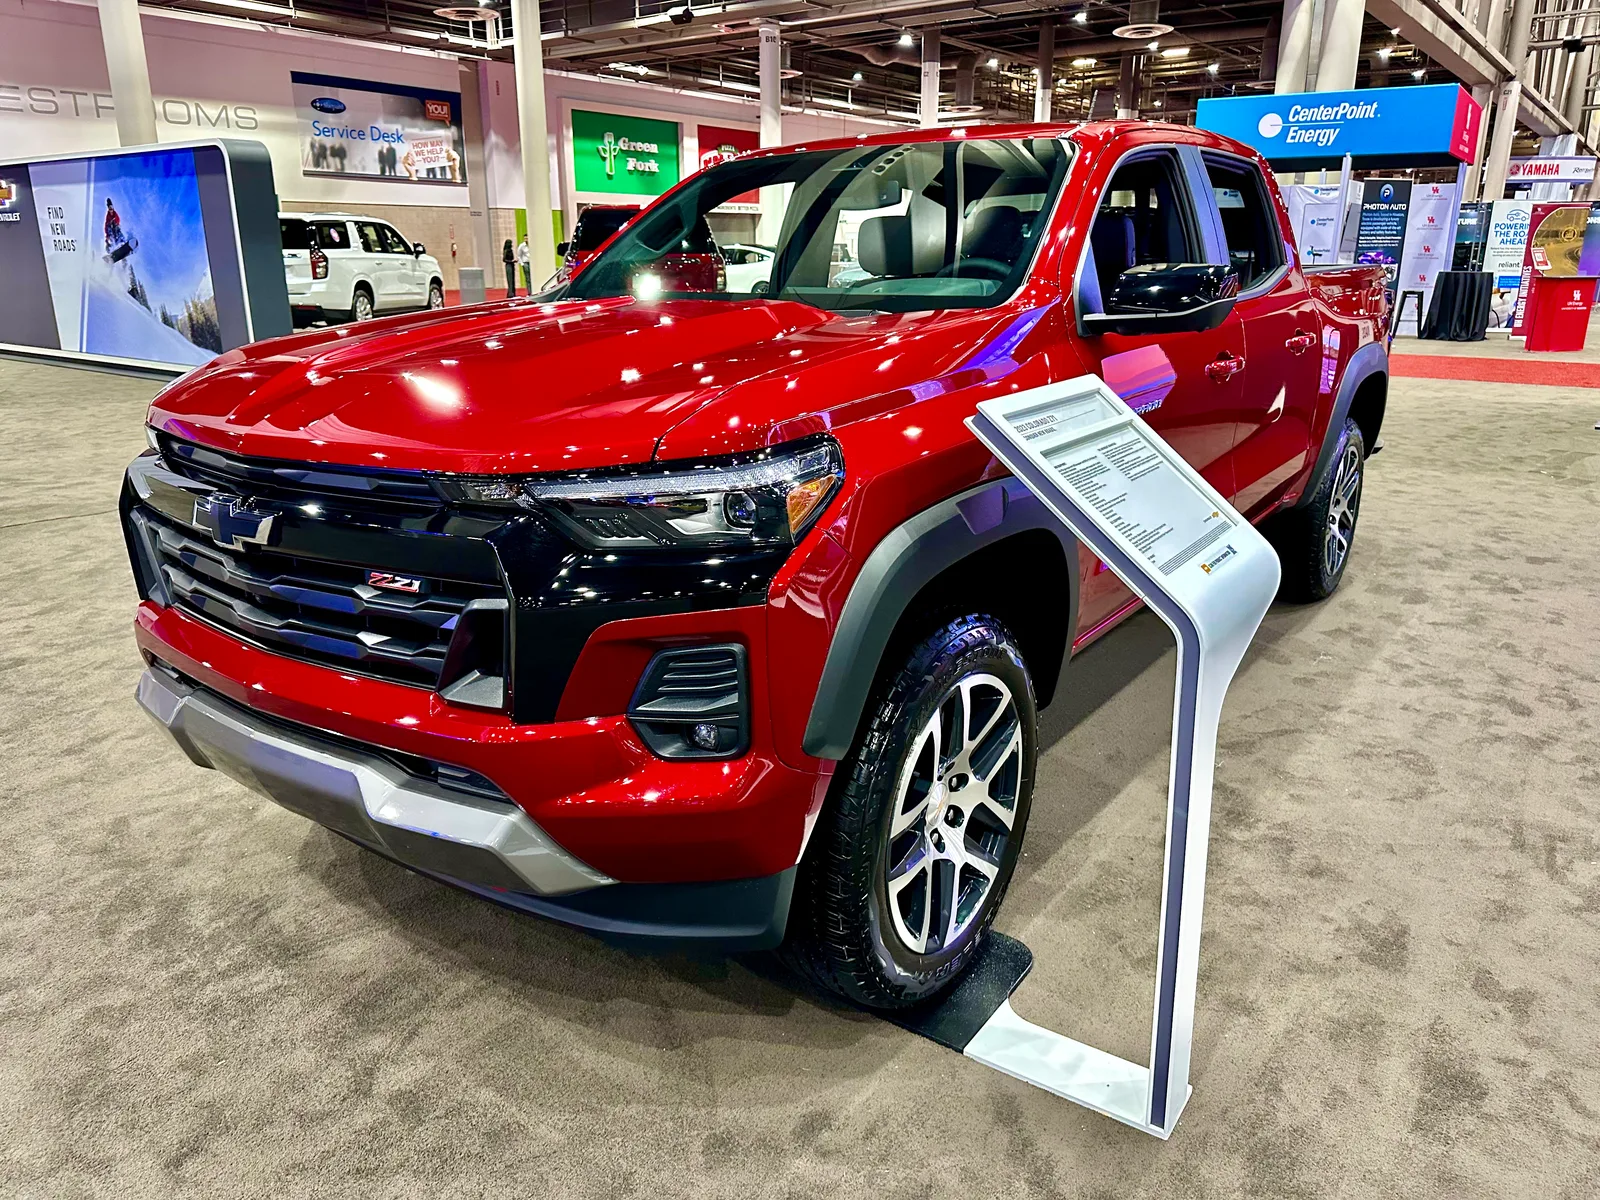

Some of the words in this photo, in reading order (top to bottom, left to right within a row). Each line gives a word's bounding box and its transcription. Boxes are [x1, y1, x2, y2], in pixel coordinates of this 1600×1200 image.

[1288, 101, 1378, 123] CenterPoint
[312, 120, 366, 140] Service
[370, 126, 405, 144] Desk
[1286, 126, 1340, 147] Energy
[412, 141, 429, 149] HOW
[430, 140, 444, 149] MAY
[618, 137, 659, 154] Green
[415, 149, 426, 157] WE
[426, 147, 444, 156] HELP
[626, 157, 660, 173] Fork
[1521, 163, 1560, 176] YAMAHA
[47, 206, 64, 220] FIND
[50, 223, 66, 236] NEW
[1494, 230, 1511, 238] THE
[1025, 416, 1049, 430] COLORADO
[368, 572, 421, 593] Z71
